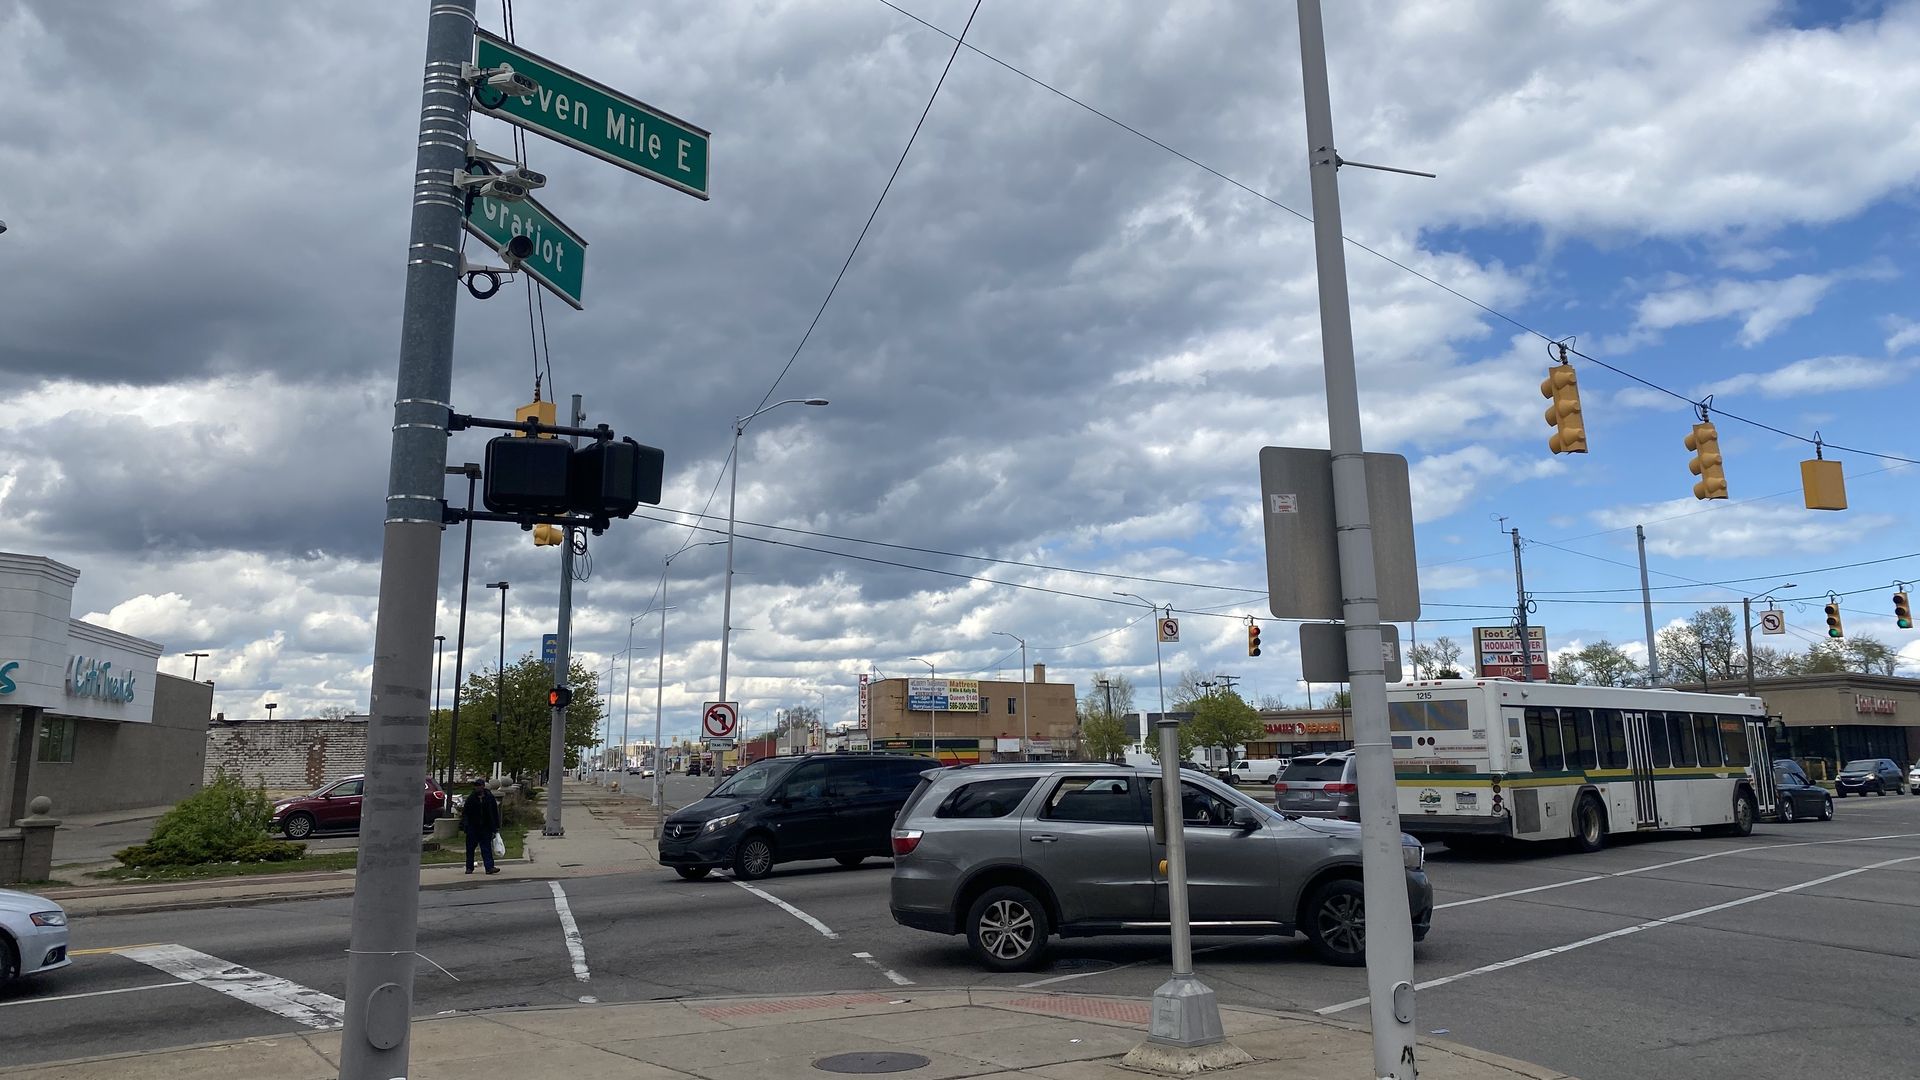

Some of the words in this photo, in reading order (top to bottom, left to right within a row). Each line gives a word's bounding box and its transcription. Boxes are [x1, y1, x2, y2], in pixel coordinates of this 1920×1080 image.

[606, 107, 661, 160] Mile
[677, 139, 691, 172] E
[482, 197, 564, 272] Gratiot
[1484, 630, 1504, 638] Foot
[1484, 641, 1514, 650] HOOKAH
[1516, 641, 1541, 649] TER
[1498, 655, 1525, 663] NAS
[101, 661, 136, 703] Trends
[949, 680, 977, 688] Mattress
[949, 694, 965, 702] Queen
[1416, 692, 1432, 700] 1215
